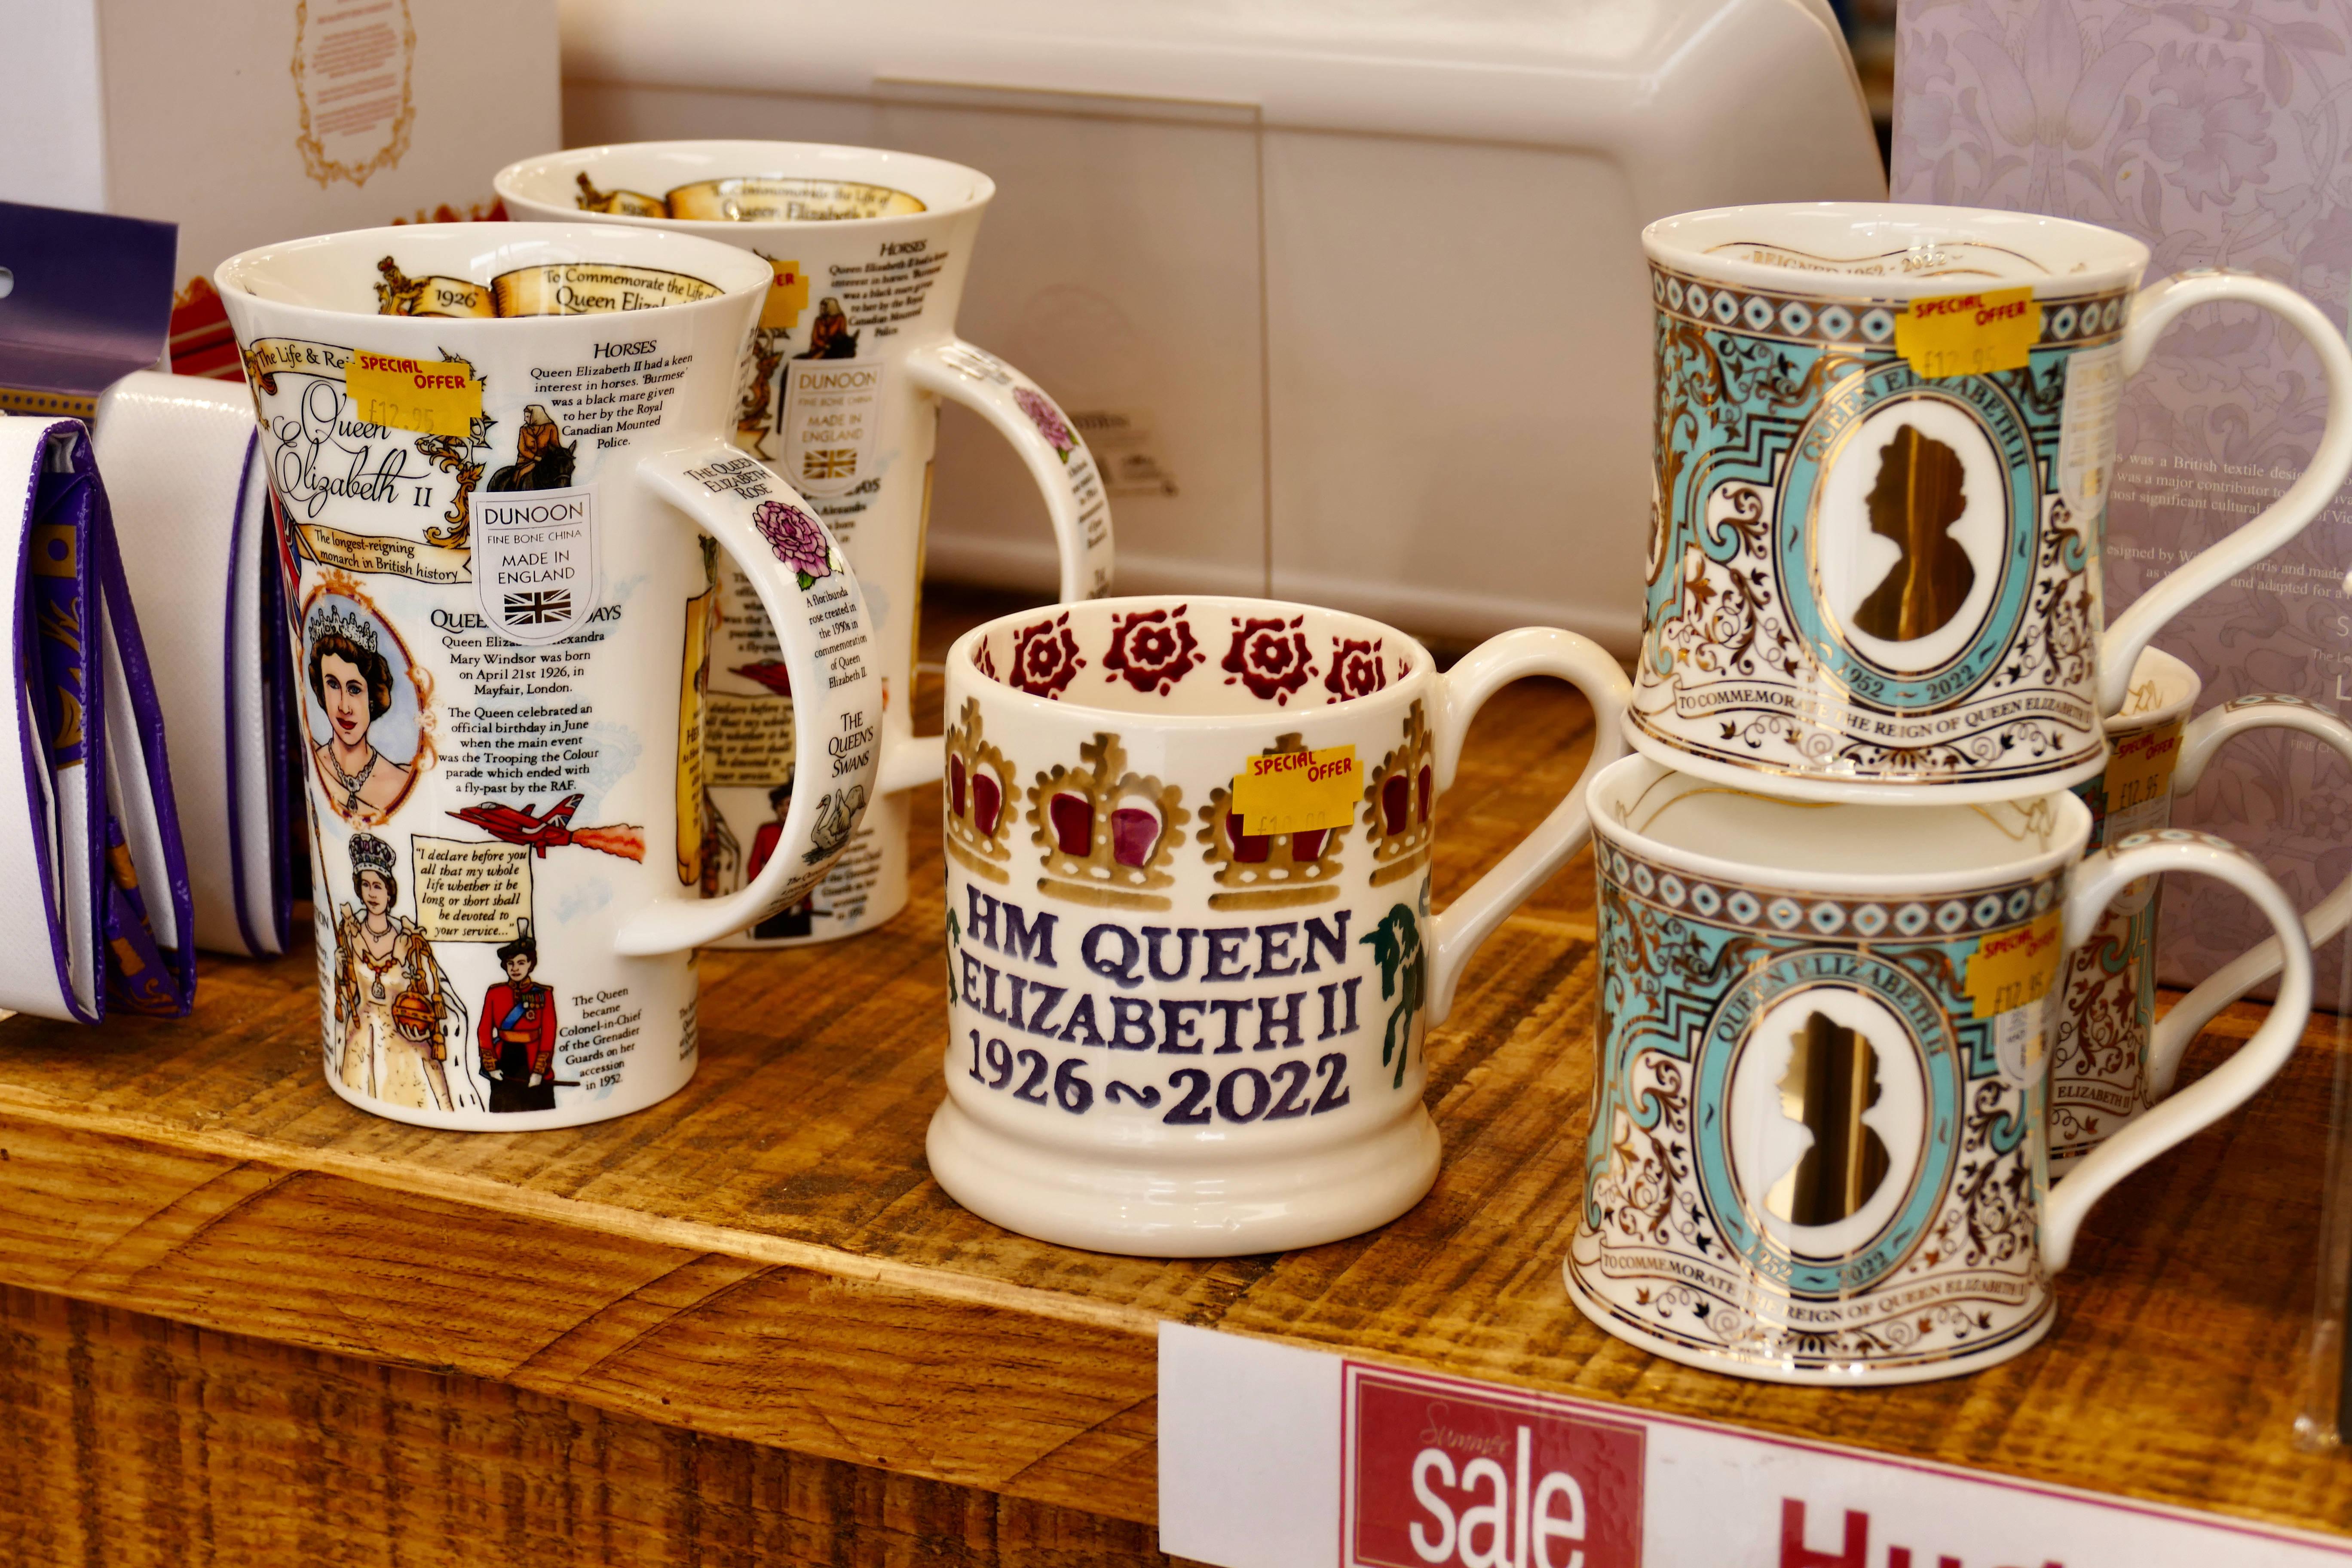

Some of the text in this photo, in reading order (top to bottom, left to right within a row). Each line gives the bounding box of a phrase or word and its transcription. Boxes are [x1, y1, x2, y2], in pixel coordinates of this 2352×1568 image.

[566, 269, 703, 300] Commemorate the Life
[435, 289, 476, 308] 1926
[557, 286, 616, 313] Queen
[1916, 295, 1984, 318] SPECIAL
[1975, 301, 2026, 326] OFFER
[257, 345, 302, 368] The Life
[594, 340, 656, 358] HORSES
[361, 357, 422, 372] SPECIAL
[531, 354, 693, 380] Queen Elizabeth had keen
[414, 376, 465, 389] OFFER
[535, 378, 638, 392] interest horses.
[799, 371, 877, 389] DUNOON
[586, 387, 674, 404] black mare given
[302, 380, 391, 444] Queen
[617, 401, 663, 417] the Royal
[562, 416, 661, 436] Canadian Mounted
[807, 414, 844, 426] MADE
[1802, 387, 1877, 462] QUEEN
[597, 438, 630, 449] Police.
[802, 429, 863, 443] ENGLAND
[273, 416, 432, 518] Elizabeth II
[684, 458, 754, 481] THE QUEEN
[2130, 455, 2153, 466] was
[2174, 456, 2217, 472] British
[2223, 464, 2263, 477] textile
[704, 469, 772, 493] ELIZABETH
[2117, 473, 2269, 496] was major contributor
[733, 484, 772, 499] ROSE
[485, 502, 582, 524] DUNOON
[2140, 493, 2260, 514] significant cultural
[315, 530, 415, 558] The longest-reigning
[514, 530, 582, 543] BONE CHINA
[321, 550, 457, 583] monarch British history
[502, 552, 548, 567] MADE
[499, 567, 575, 584] ENGLAND
[2282, 561, 2344, 580] and made
[813, 586, 848, 606] floribunda
[2231, 578, 2331, 597] and adapted for
[809, 602, 849, 625] rose created
[819, 622, 851, 639] the 1950s
[442, 636, 482, 649] Queen
[815, 634, 867, 658] commemoration
[450, 651, 591, 666] Mary Windsor born
[839, 655, 860, 669] Queen
[476, 668, 570, 682] April 1926,
[829, 670, 860, 688] Elizabeth
[1926, 665, 1975, 700] 2022
[474, 683, 572, 698] Mayfair, London.
[474, 704, 577, 720] Queen celebrated
[841, 711, 863, 732] THE
[1698, 689, 2022, 738] COMMEMORATE THE REIGN QUEEN
[451, 721, 588, 735] official birthday June
[460, 736, 582, 748] when main event
[2118, 733, 2155, 759] SPECIAL
[2146, 738, 2174, 760] OFFER
[484, 749, 599, 765] Trooping Colour
[832, 750, 870, 778] SWANS
[1254, 751, 1317, 776] SPECIAL
[446, 764, 589, 779] parade which ended with
[1308, 758, 1351, 782] OFFER
[465, 780, 576, 795] fly-past RAF.
[428, 849, 527, 864] declare before you
[421, 864, 519, 876] all that whole
[427, 878, 490, 892] life whether
[422, 892, 521, 907] long short shall
[453, 910, 496, 921] devoted
[435, 927, 459, 937] your
[966, 883, 1351, 989] HM QUEEN
[572, 988, 628, 1006] The Queen
[960, 949, 1363, 1055] ELIZABETH II
[1792, 956, 1939, 1034] ELIZABETH
[583, 1004, 621, 1019] became
[560, 1009, 641, 1037] Colonel-in-Chief
[573, 1027, 640, 1050] the Grenadier
[566, 1043, 635, 1065] Guards her
[580, 1060, 625, 1077] accession
[2058, 1087, 2122, 1107] ELIZABETH
[1746, 1243, 1794, 1282] 1952
[1620, 1255, 1738, 1294] COMMEMORATE
[1787, 1305, 1842, 1324] REIGN
[1878, 1284, 1941, 1312] QUEEN
[1420, 1400, 1511, 1457] Summer
[1409, 1425, 1586, 1568] sale
